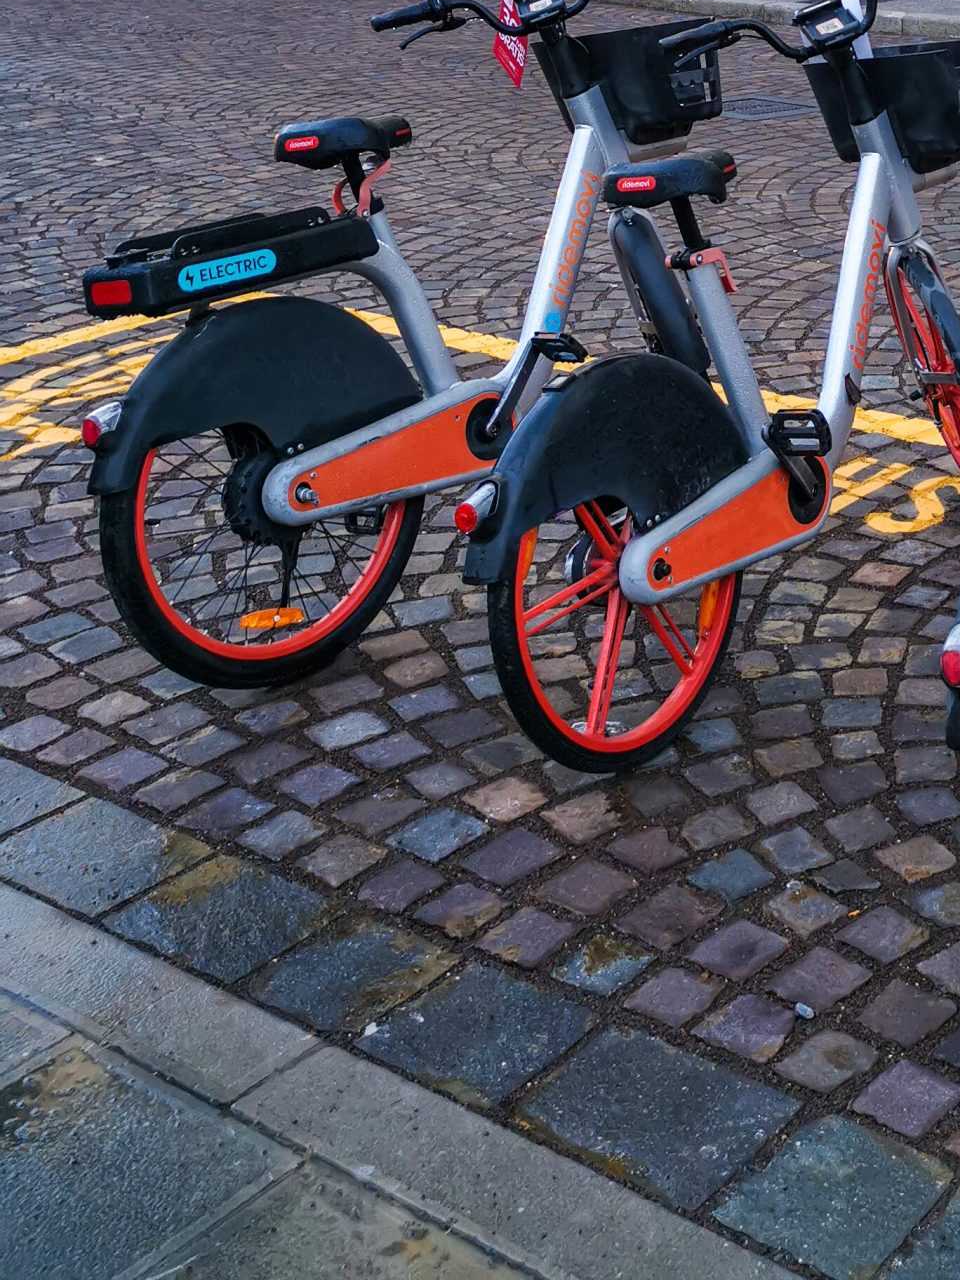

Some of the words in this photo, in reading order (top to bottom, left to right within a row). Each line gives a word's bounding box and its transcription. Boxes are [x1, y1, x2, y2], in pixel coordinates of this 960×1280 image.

[200, 256, 267, 282] ELECTRIC
[549, 172, 600, 308] ridemovi
[849, 219, 888, 370] ridemovi
